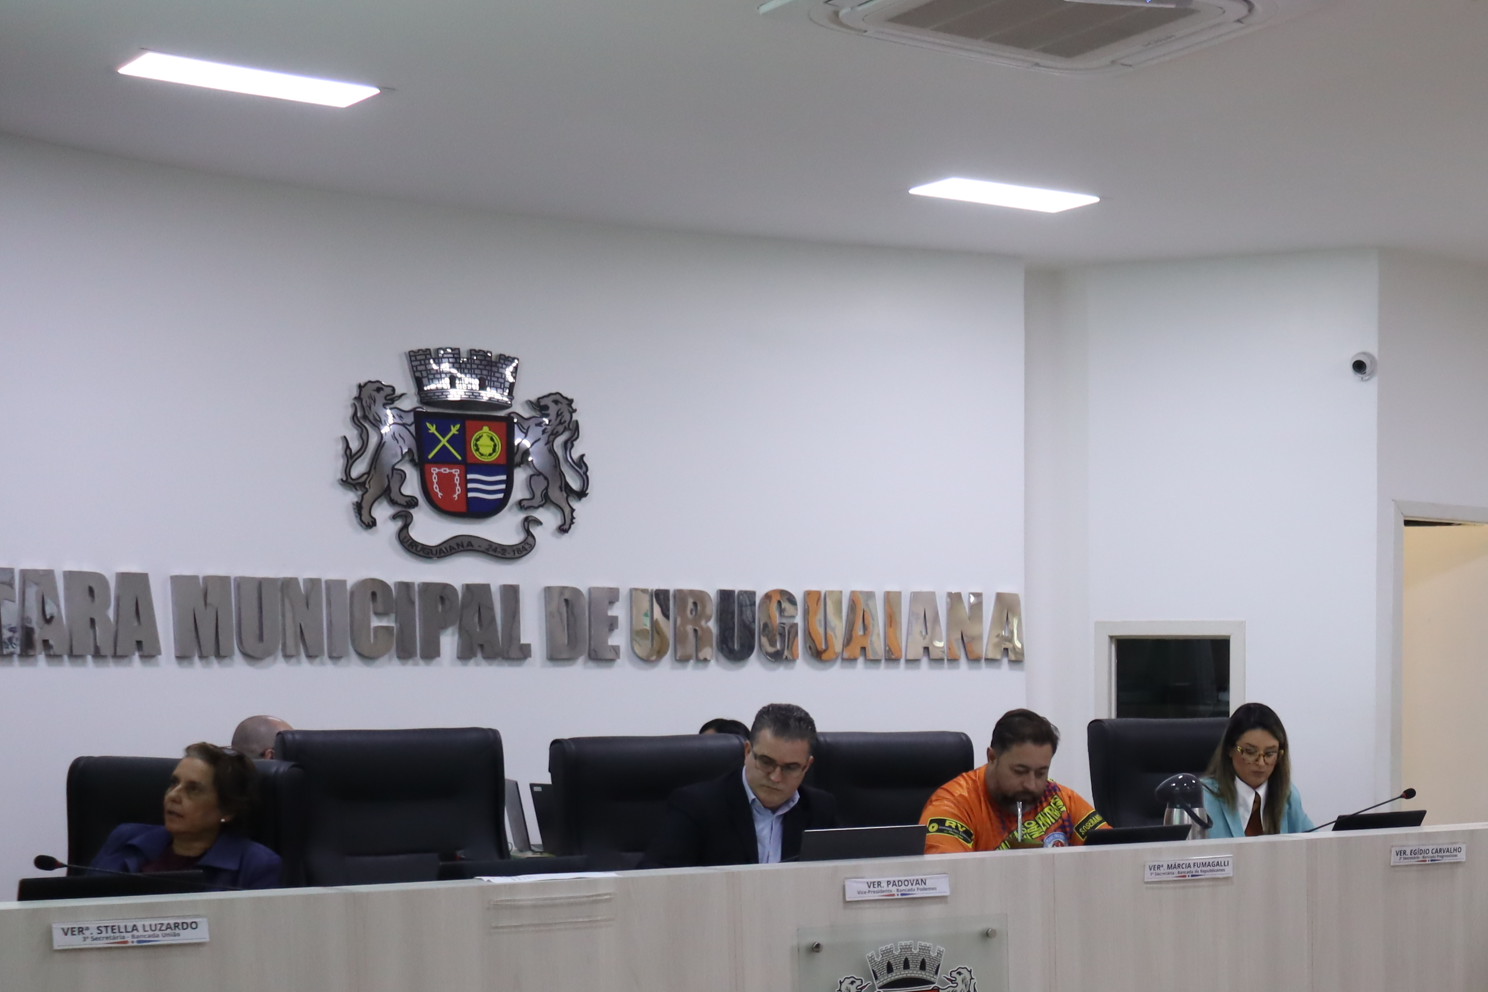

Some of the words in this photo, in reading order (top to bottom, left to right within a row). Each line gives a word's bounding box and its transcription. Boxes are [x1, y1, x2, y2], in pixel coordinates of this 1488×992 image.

[402, 535, 474, 557] URUGUAIANA
[0, 567, 162, 660] ARA
[170, 573, 532, 661] MUNICIPAL
[544, 585, 621, 661] DE
[629, 587, 1026, 663] URUGUAIANA
[1395, 849, 1409, 857] VER.
[1410, 847, 1430, 856] EGÍDIO
[1431, 846, 1462, 855] CARVALHO
[1167, 862, 1192, 871] MÁRCIA
[1193, 860, 1230, 868] FUMAGALLI
[866, 880, 884, 889] VER.
[886, 878, 927, 888] PADOVAN
[96, 923, 139, 935] STELLA
[142, 920, 199, 933] LUZARDO
